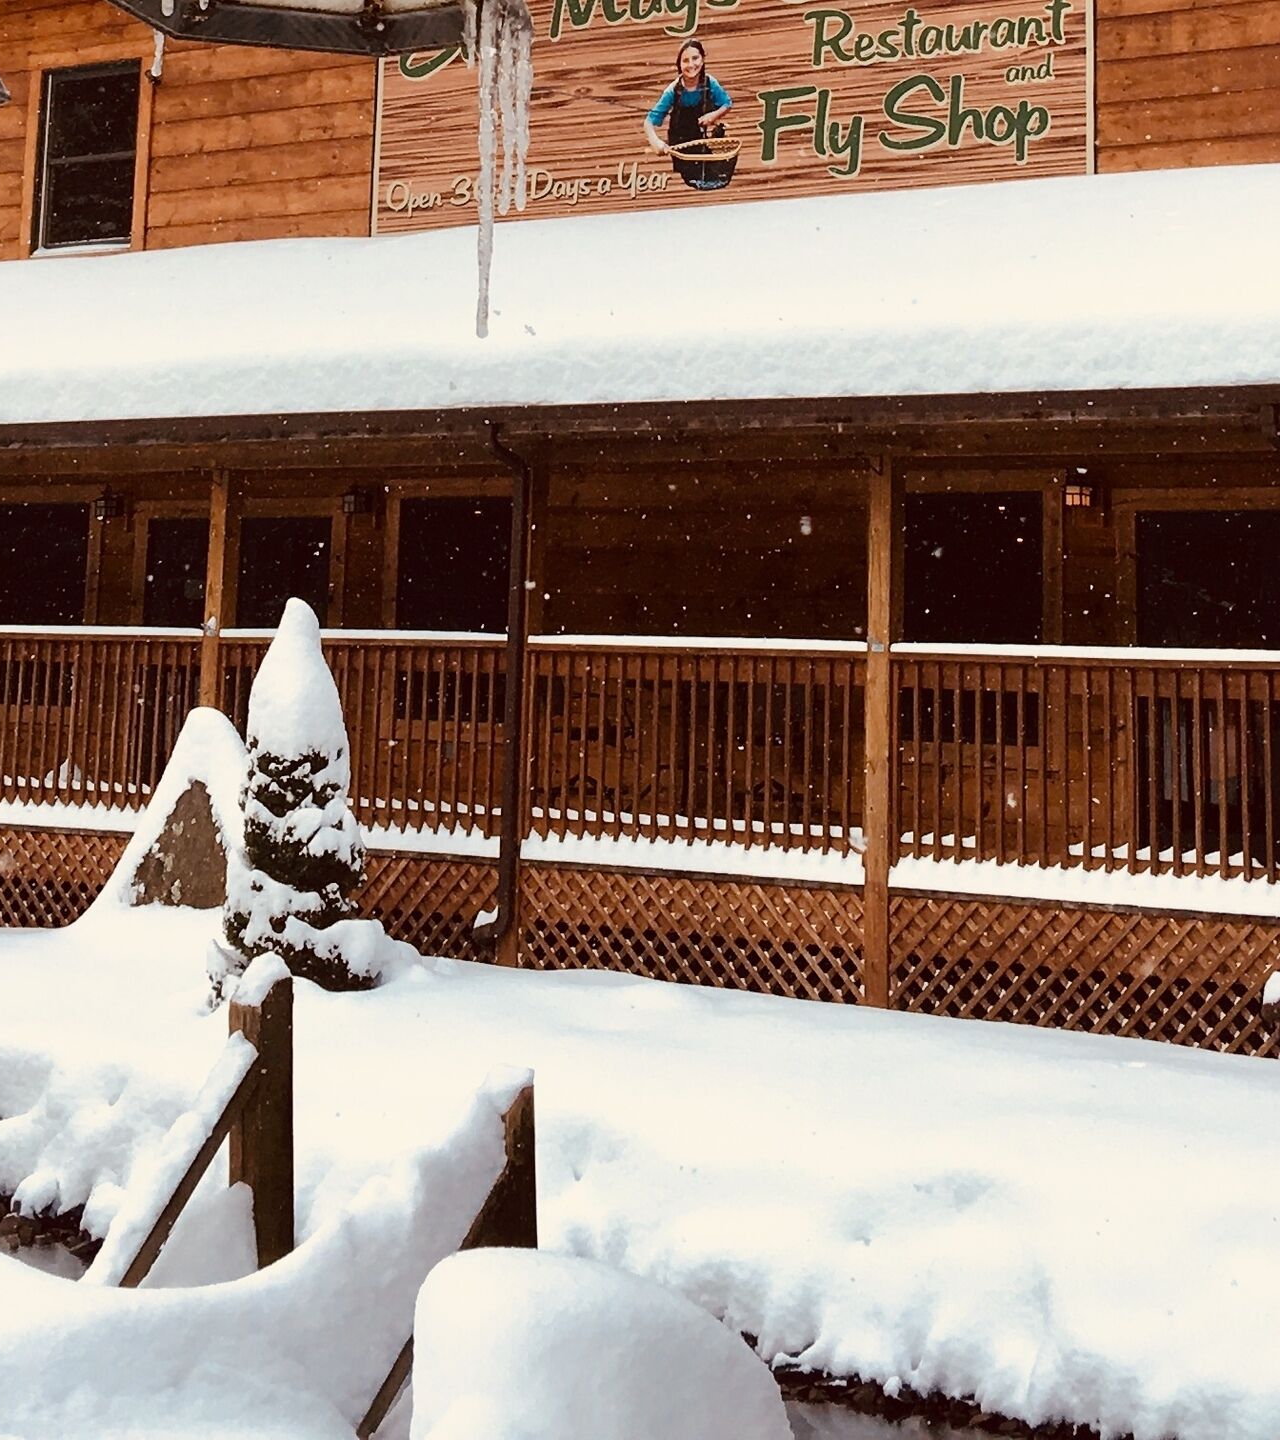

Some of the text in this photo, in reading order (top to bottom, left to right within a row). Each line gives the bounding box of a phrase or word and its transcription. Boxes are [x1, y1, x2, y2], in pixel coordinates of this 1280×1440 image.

[1005, 54, 1054, 85] and
[757, 73, 1050, 178] Fly Shop
[385, 180, 443, 217] Open
[528, 168, 593, 205] Days
[597, 176, 612, 194] a
[617, 161, 672, 198] Year
